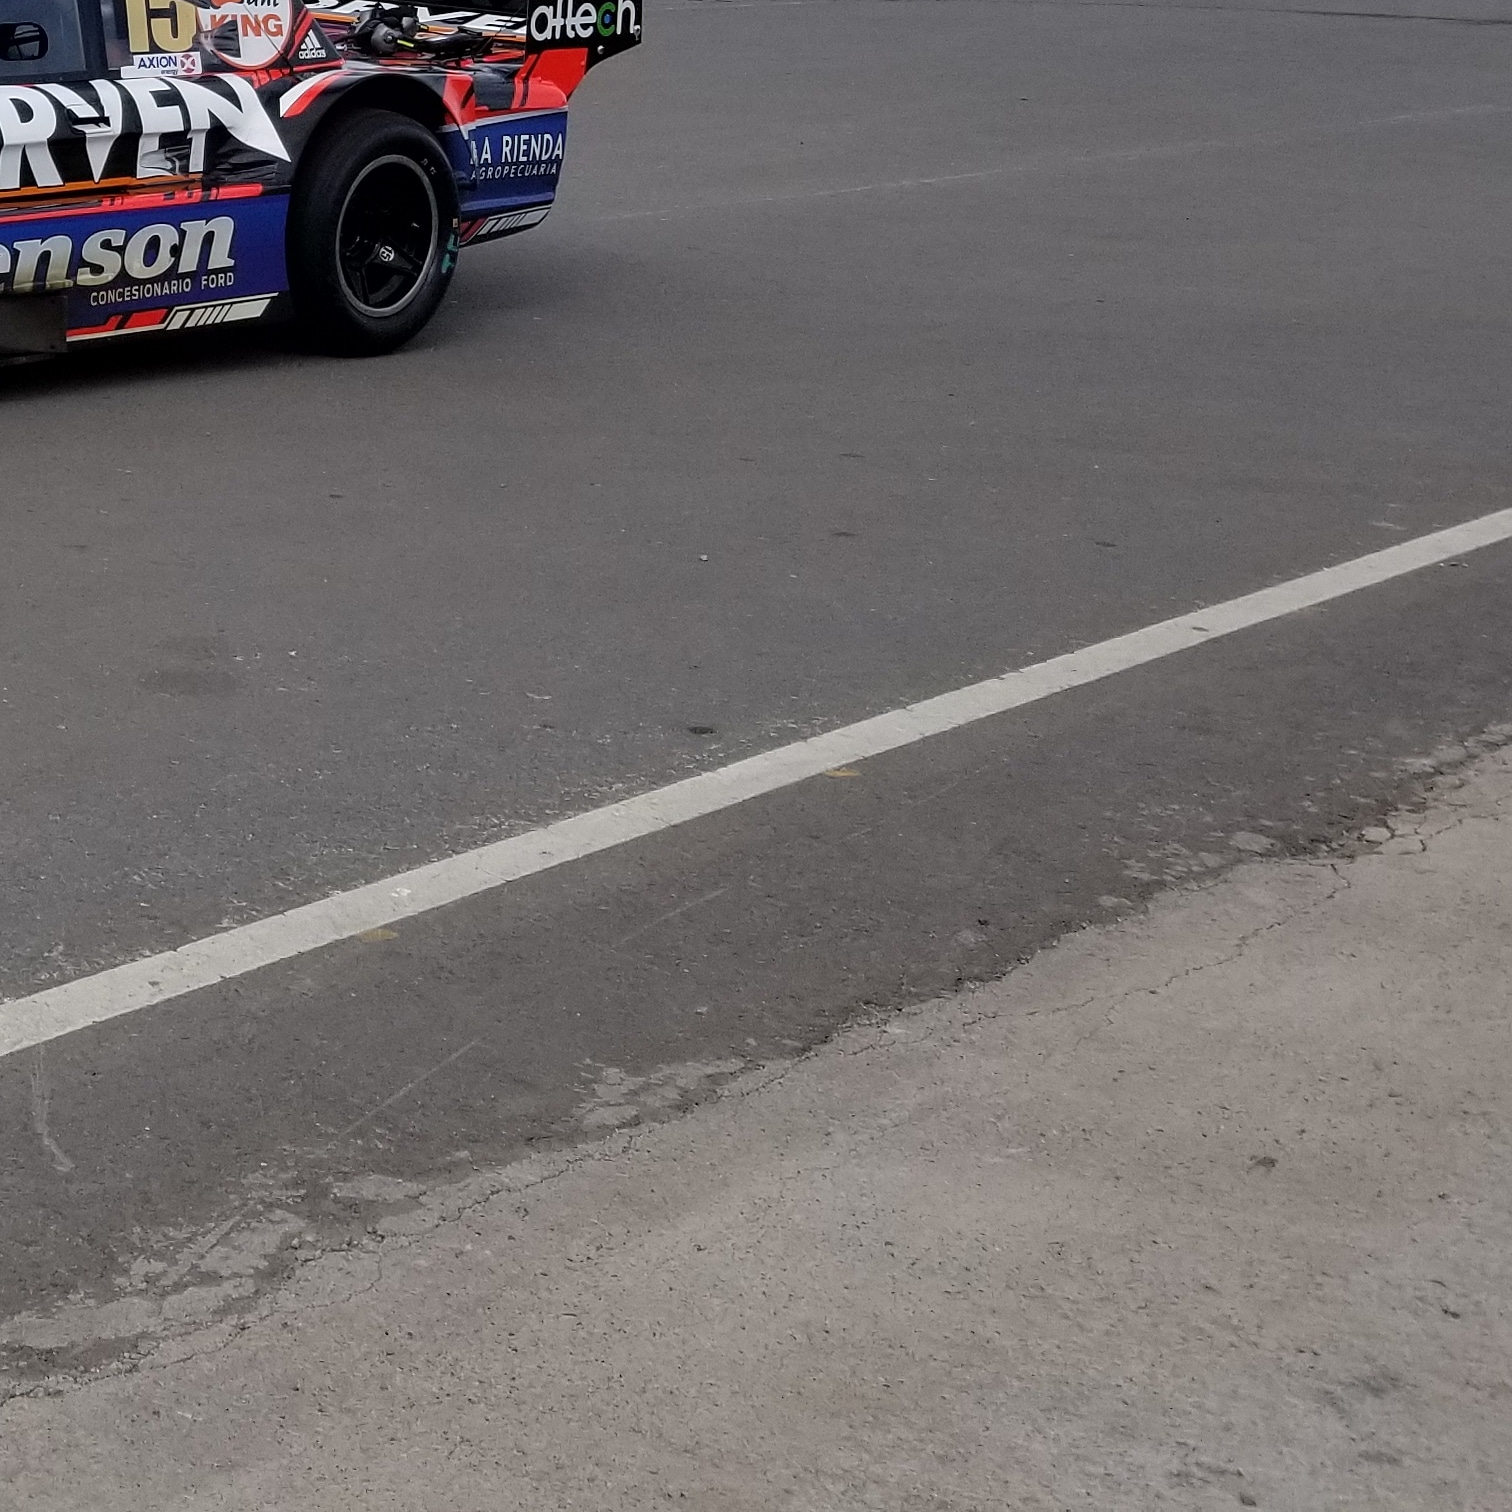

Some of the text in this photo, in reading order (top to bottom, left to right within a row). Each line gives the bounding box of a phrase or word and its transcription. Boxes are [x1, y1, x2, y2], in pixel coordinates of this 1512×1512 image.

[138, 55, 178, 69] AXION
[298, 48, 327, 59] adidas
[501, 133, 563, 163] RIENDA
[470, 163, 558, 180] AGROPECUARIA
[90, 272, 235, 306] CONCESIONARIO FORD
